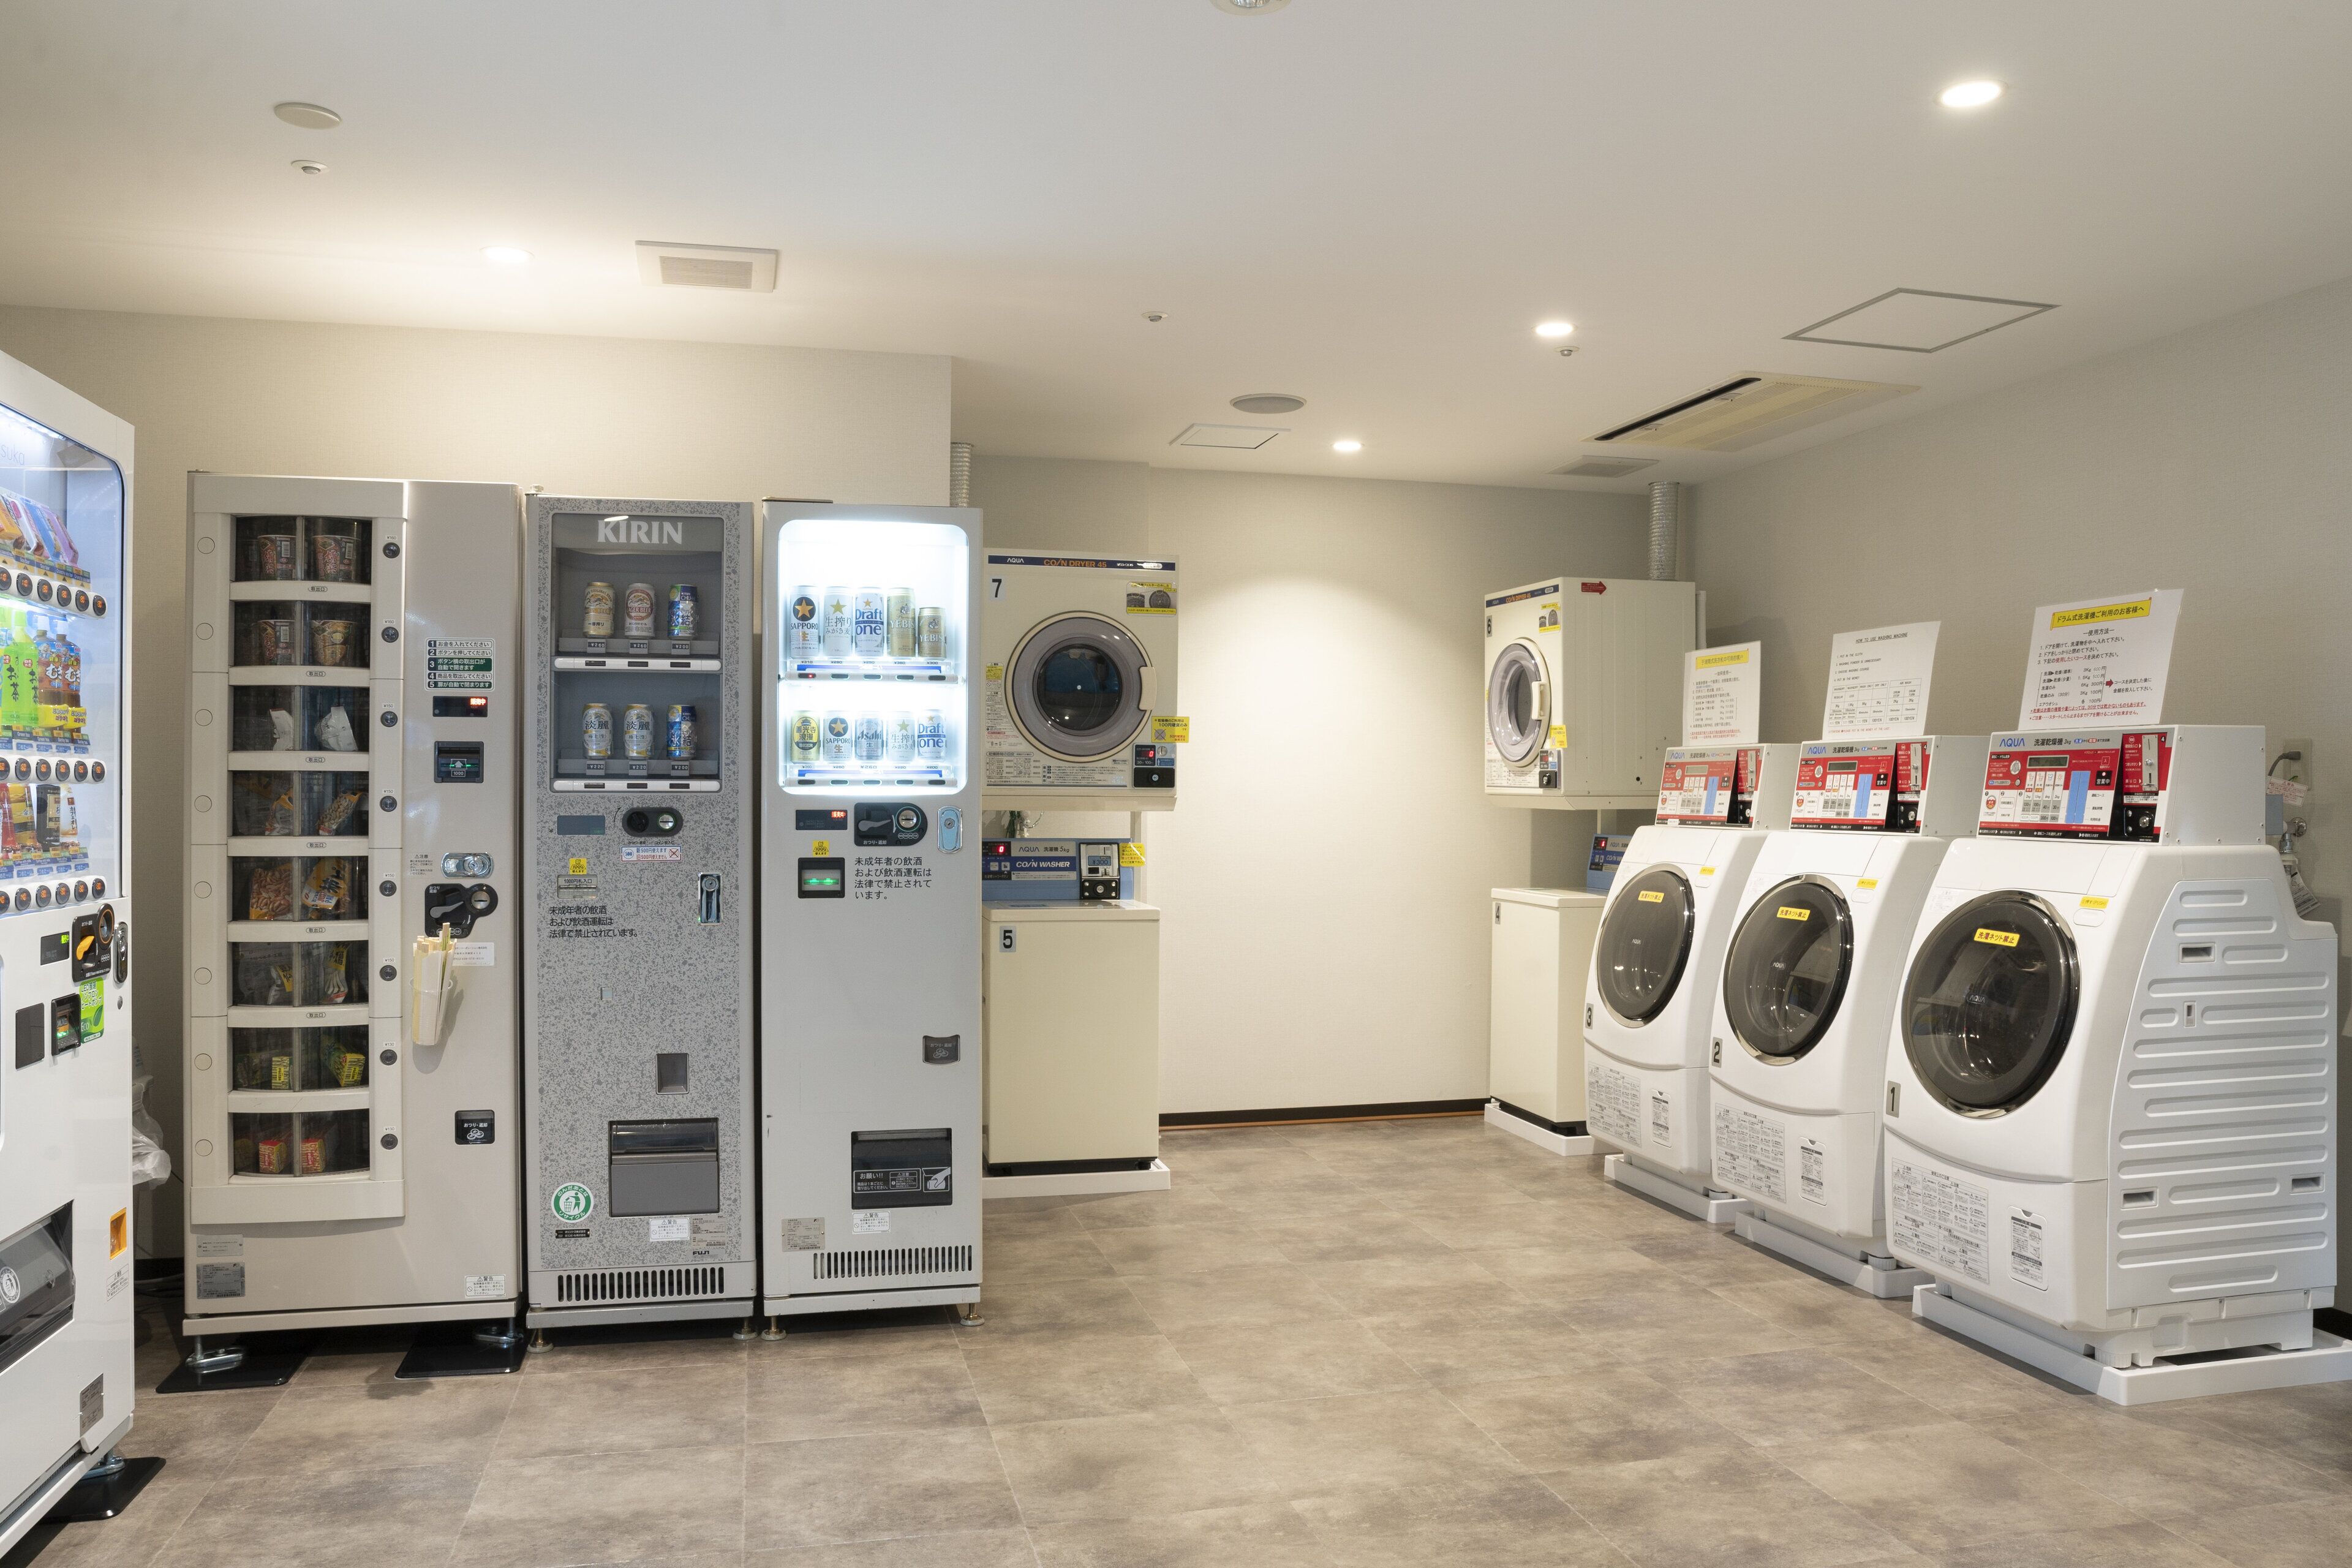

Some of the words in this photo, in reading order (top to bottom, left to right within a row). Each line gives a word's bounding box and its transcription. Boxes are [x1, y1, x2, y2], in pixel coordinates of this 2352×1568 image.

[597, 520, 683, 545] KIRIN
[992, 578, 1002, 598] 7
[1515, 593, 1527, 601] DRYER
[856, 609, 883, 620] Draft
[2057, 606, 2144, 623] ドラム式洗濯機ご利用のお客様へ
[825, 616, 851, 627] 生搾り
[1487, 619, 1491, 634] 6
[856, 625, 881, 635] one
[2045, 636, 2125, 650] ドアを開けて、洗濯物を中へ入れて下さい。
[2044, 647, 2099, 657] ドアをしっかりと閉めて下さい。
[2043, 652, 2119, 664] 下記の使用したいコースを決めて下さい。
[7, 665, 19, 702] お茶
[585, 720, 609, 730] 淡麗
[626, 720, 650, 731] 淡麗
[919, 723, 944, 733] Draft
[858, 730, 881, 741] Asahi
[919, 738, 943, 748] one
[1999, 738, 2025, 747] AQUA
[2034, 737, 2064, 747] 洗濯乾燥機
[834, 744, 843, 753] 生
[854, 857, 922, 866] 未成年者の飲酒
[854, 868, 932, 877] および飲酒運転は
[854, 880, 932, 889] 法律で禁止されて
[855, 891, 889, 900] います。
[549, 905, 607, 915] 未成年者の飲酒
[1496, 906, 1500, 921] 4
[1779, 909, 1807, 918] 洗濯ネット禁止
[549, 918, 614, 926] および飲酒運転は
[549, 929, 638, 938] 法律で禁止されています。
[1003, 929, 1013, 948] 5
[1977, 932, 2015, 944] 洗濯ネット禁止
[1586, 1007, 1593, 1028] 3
[1714, 1041, 1720, 1064] 2
[1890, 1087, 1896, 1112] 1
[557, 1185, 589, 1197] のんだあとは
[559, 1210, 586, 1220] リサイクル
